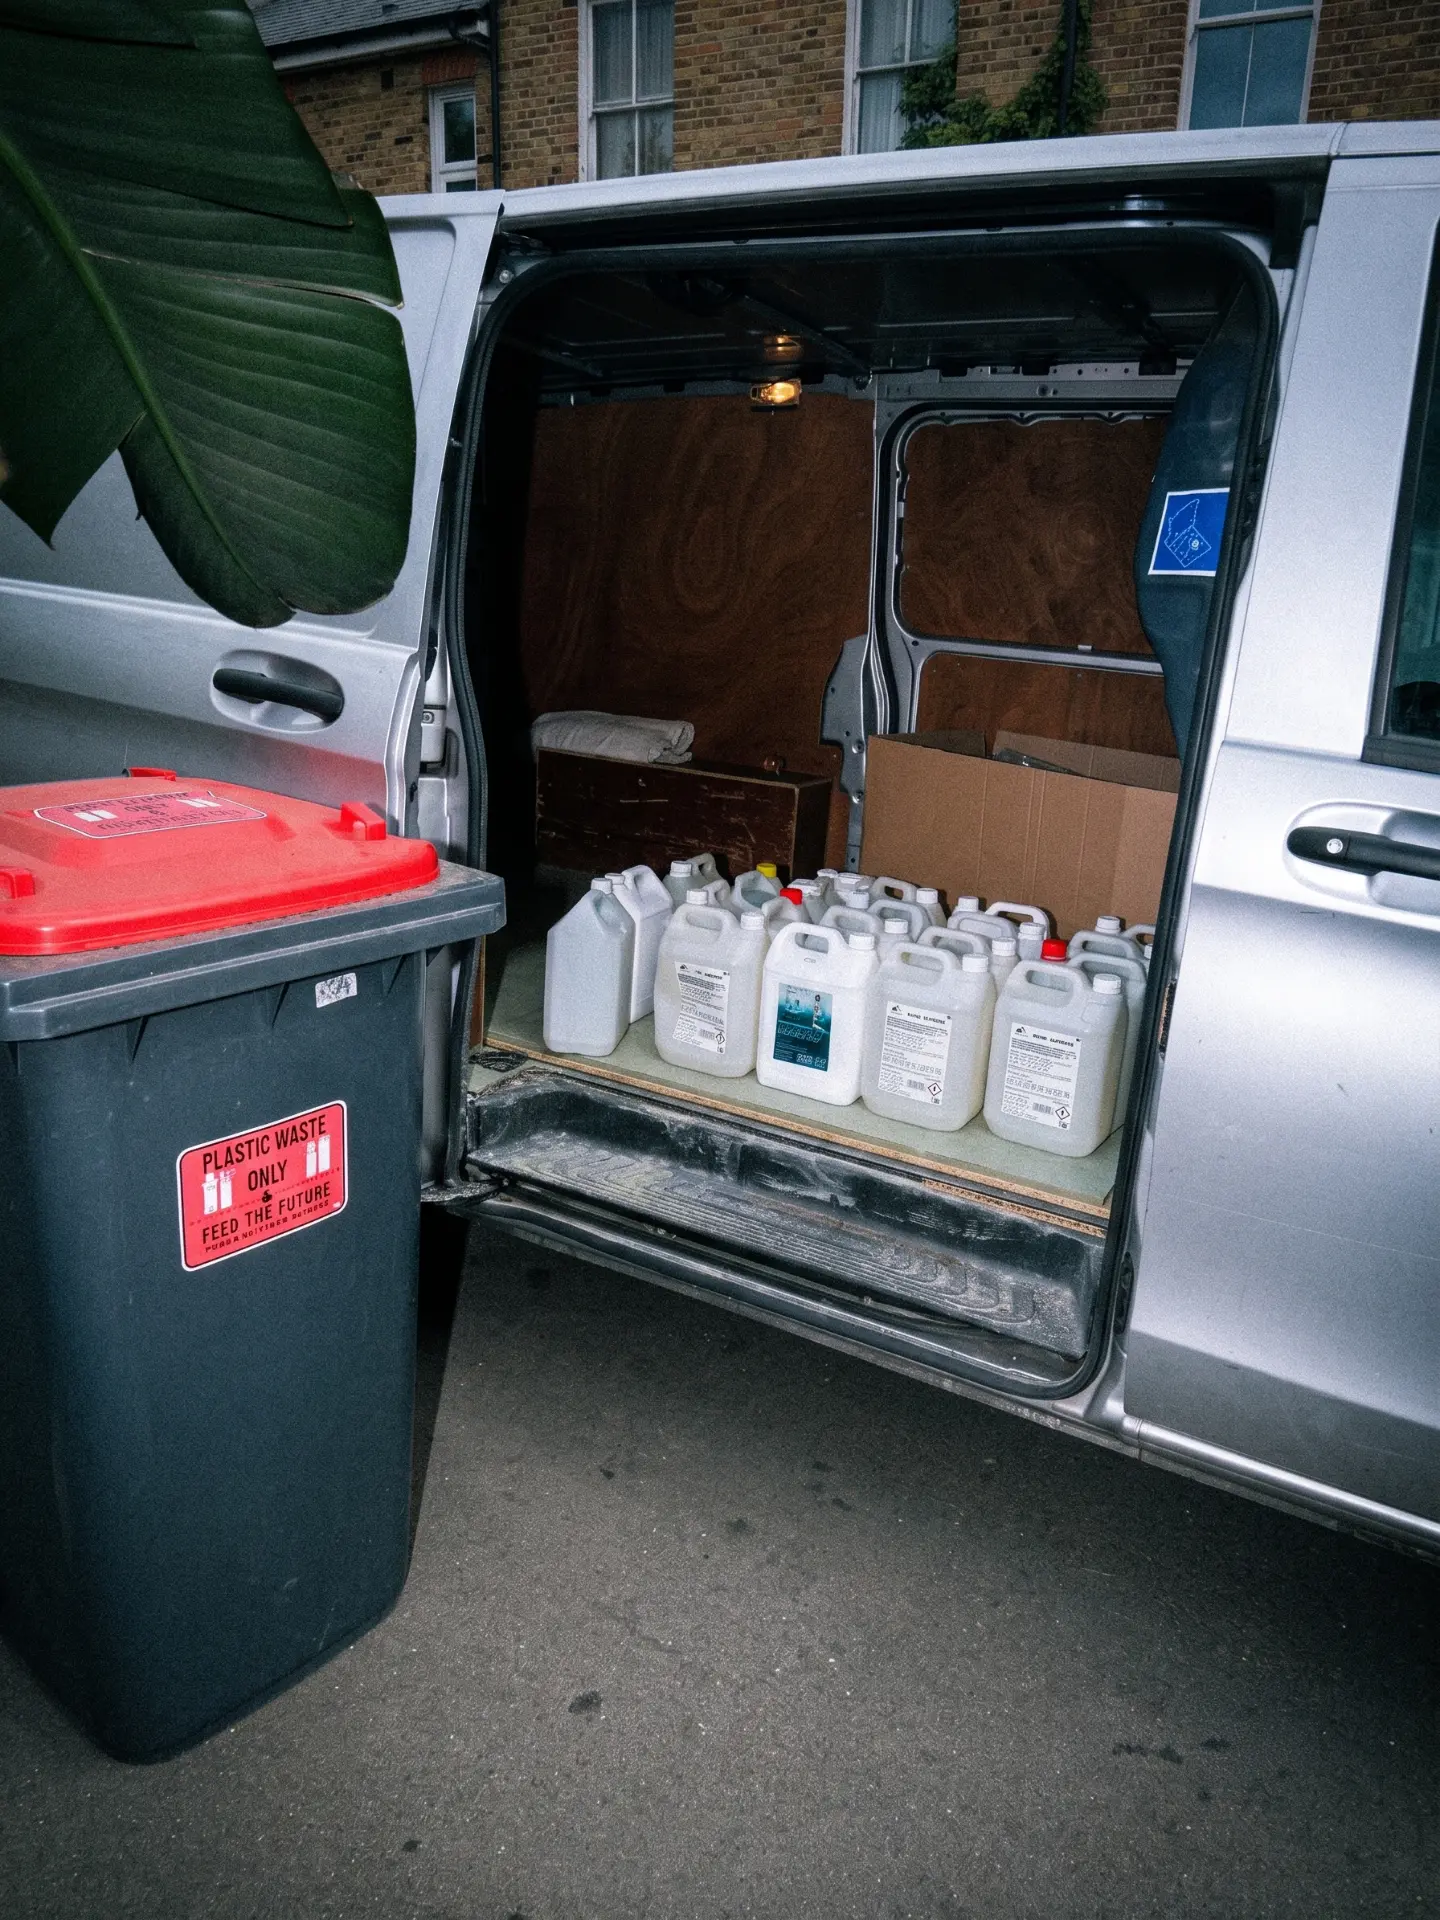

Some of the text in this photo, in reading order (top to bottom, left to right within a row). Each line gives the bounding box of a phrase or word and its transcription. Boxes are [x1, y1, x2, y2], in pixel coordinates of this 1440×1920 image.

[203, 1114, 327, 1174] PLASTIC WASTE
[248, 1159, 288, 1191] ONLY
[202, 1218, 238, 1244] FEED
[245, 1204, 272, 1227] THE
[278, 1181, 331, 1215] FUTURE
